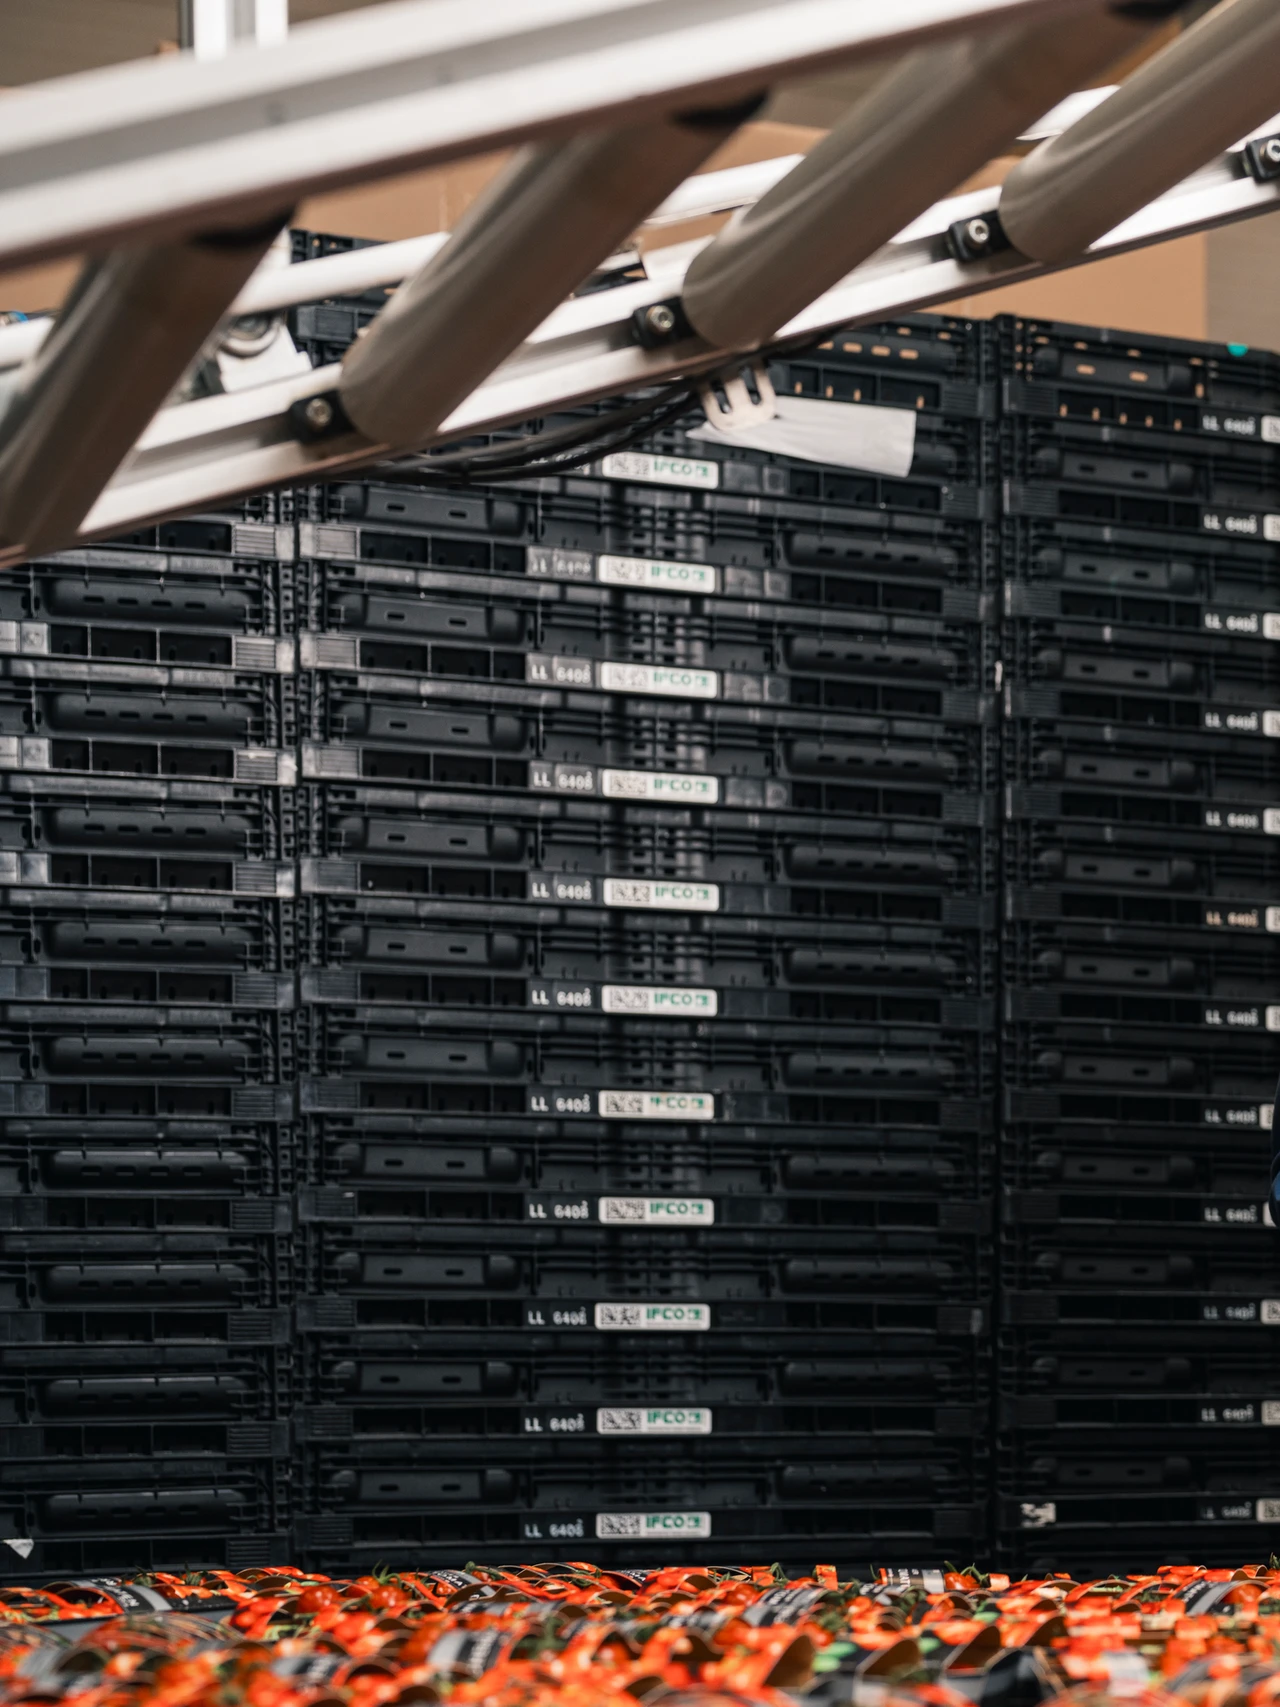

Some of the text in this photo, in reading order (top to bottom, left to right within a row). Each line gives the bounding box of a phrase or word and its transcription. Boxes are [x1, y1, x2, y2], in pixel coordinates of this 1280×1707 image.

[654, 461, 691, 475] IFCO
[651, 566, 689, 579] IFCO
[654, 672, 691, 686] IFCO
[654, 779, 692, 792] IFCO
[656, 886, 693, 898] IFCO
[654, 993, 692, 1005] IFCO
[650, 1202, 688, 1214] IFCO
[647, 1308, 684, 1320] IFCO
[648, 1411, 686, 1423] IFCO
[647, 1517, 684, 1528] IFCO
